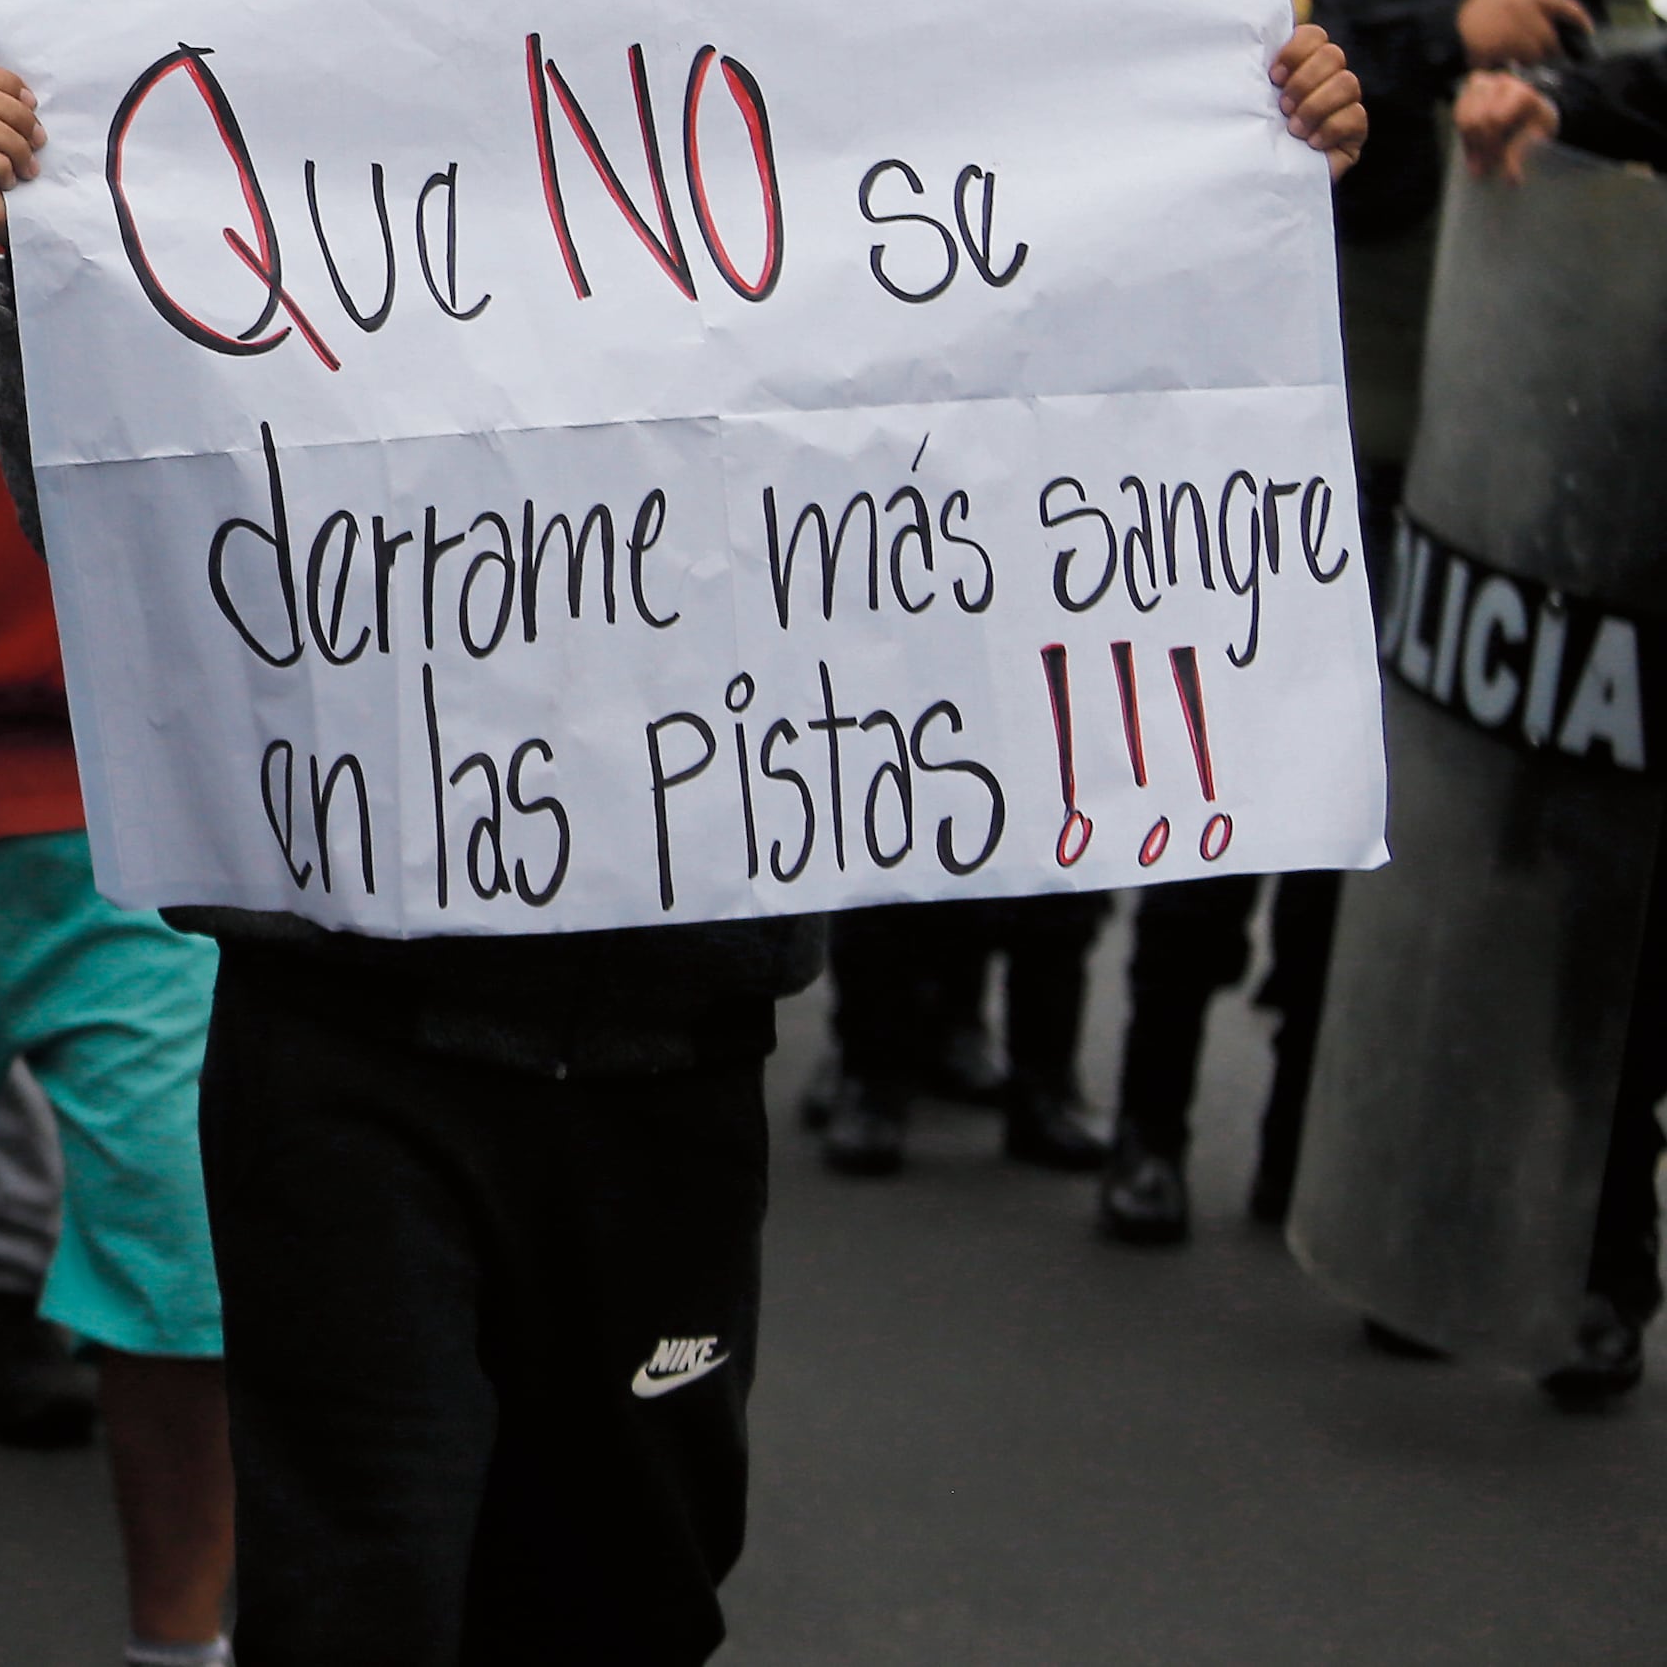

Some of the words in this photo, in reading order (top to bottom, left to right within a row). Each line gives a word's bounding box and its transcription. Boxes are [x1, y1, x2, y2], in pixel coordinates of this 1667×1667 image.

[527, 32, 784, 303] NO
[858, 159, 1028, 303] se
[208, 421, 680, 668] derrame
[763, 432, 994, 630] más
[1039, 470, 1349, 667] sangre
[260, 739, 376, 895] en
[422, 662, 570, 909] las
[647, 1335, 718, 1372] NIKE
